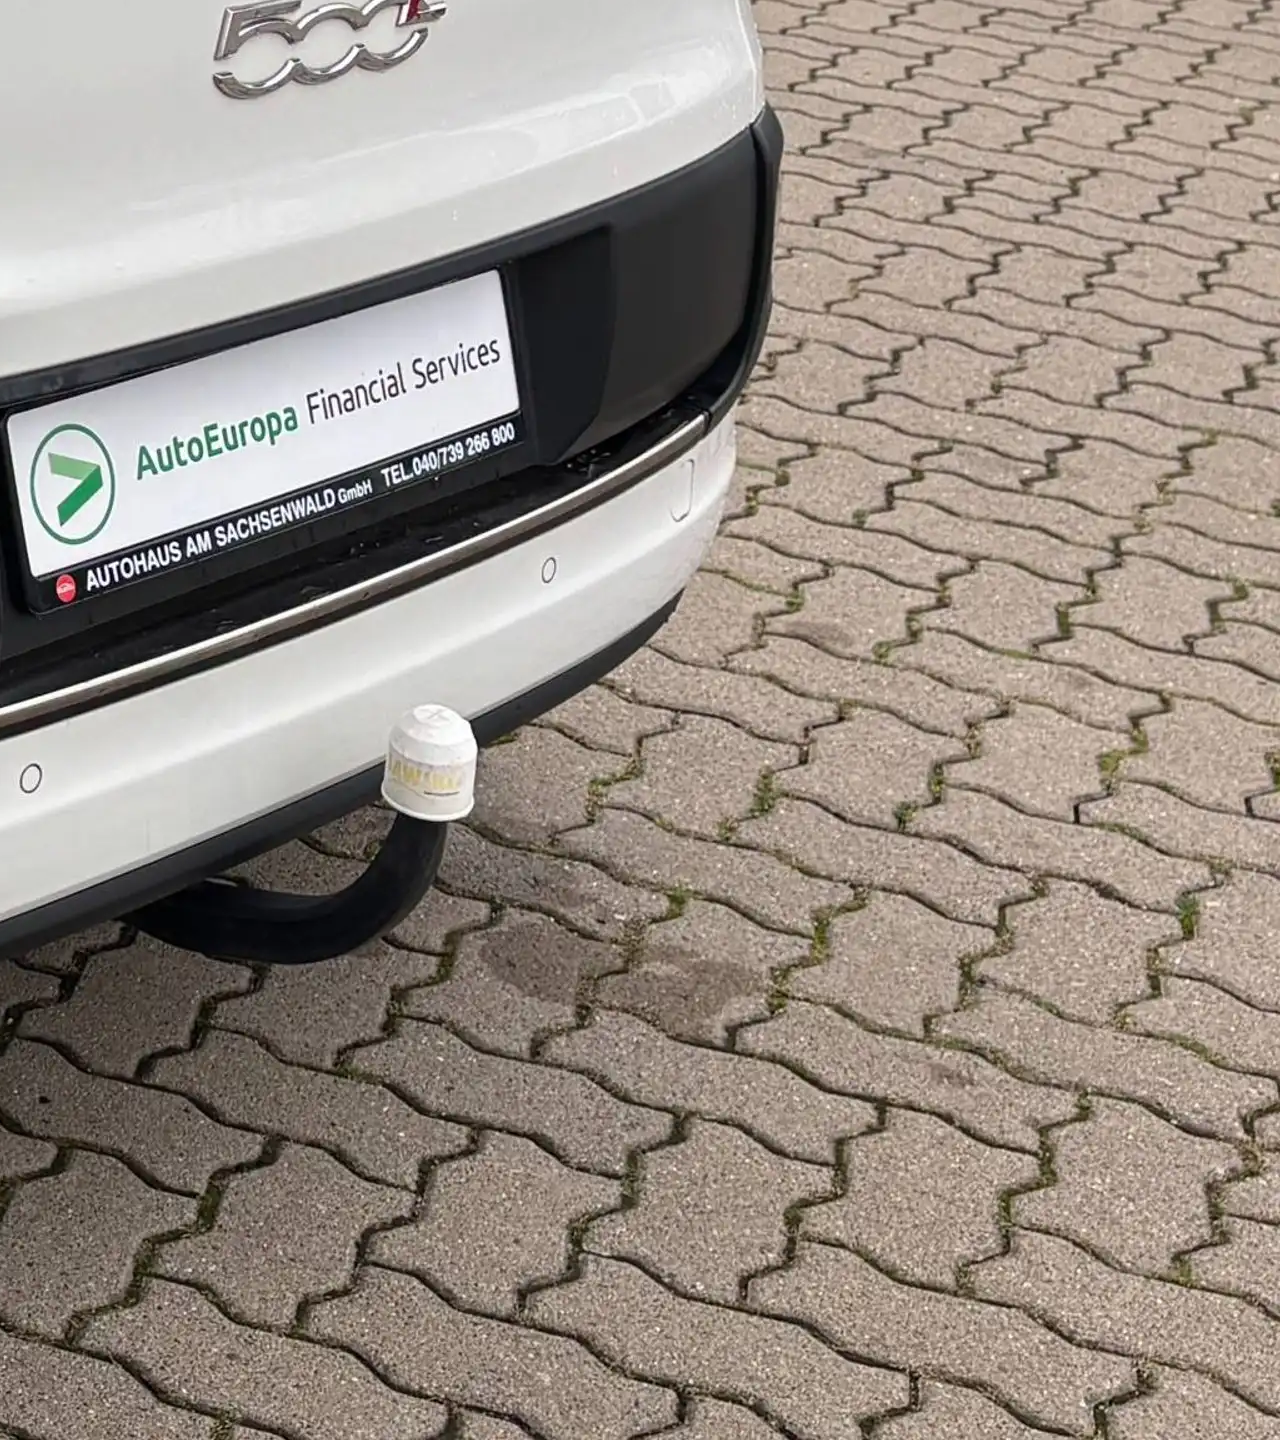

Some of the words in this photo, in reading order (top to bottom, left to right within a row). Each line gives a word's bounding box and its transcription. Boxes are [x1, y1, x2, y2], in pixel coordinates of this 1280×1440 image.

[136, 406, 299, 480] AutoEuropa
[306, 363, 407, 424] Financial
[412, 339, 501, 389] Services
[86, 541, 183, 592] AUTOHAUS
[186, 530, 212, 558] AM
[215, 487, 336, 547] SACHSENWALD
[337, 479, 373, 504] GmbH
[465, 431, 490, 458] 266
[491, 422, 516, 447] 800
